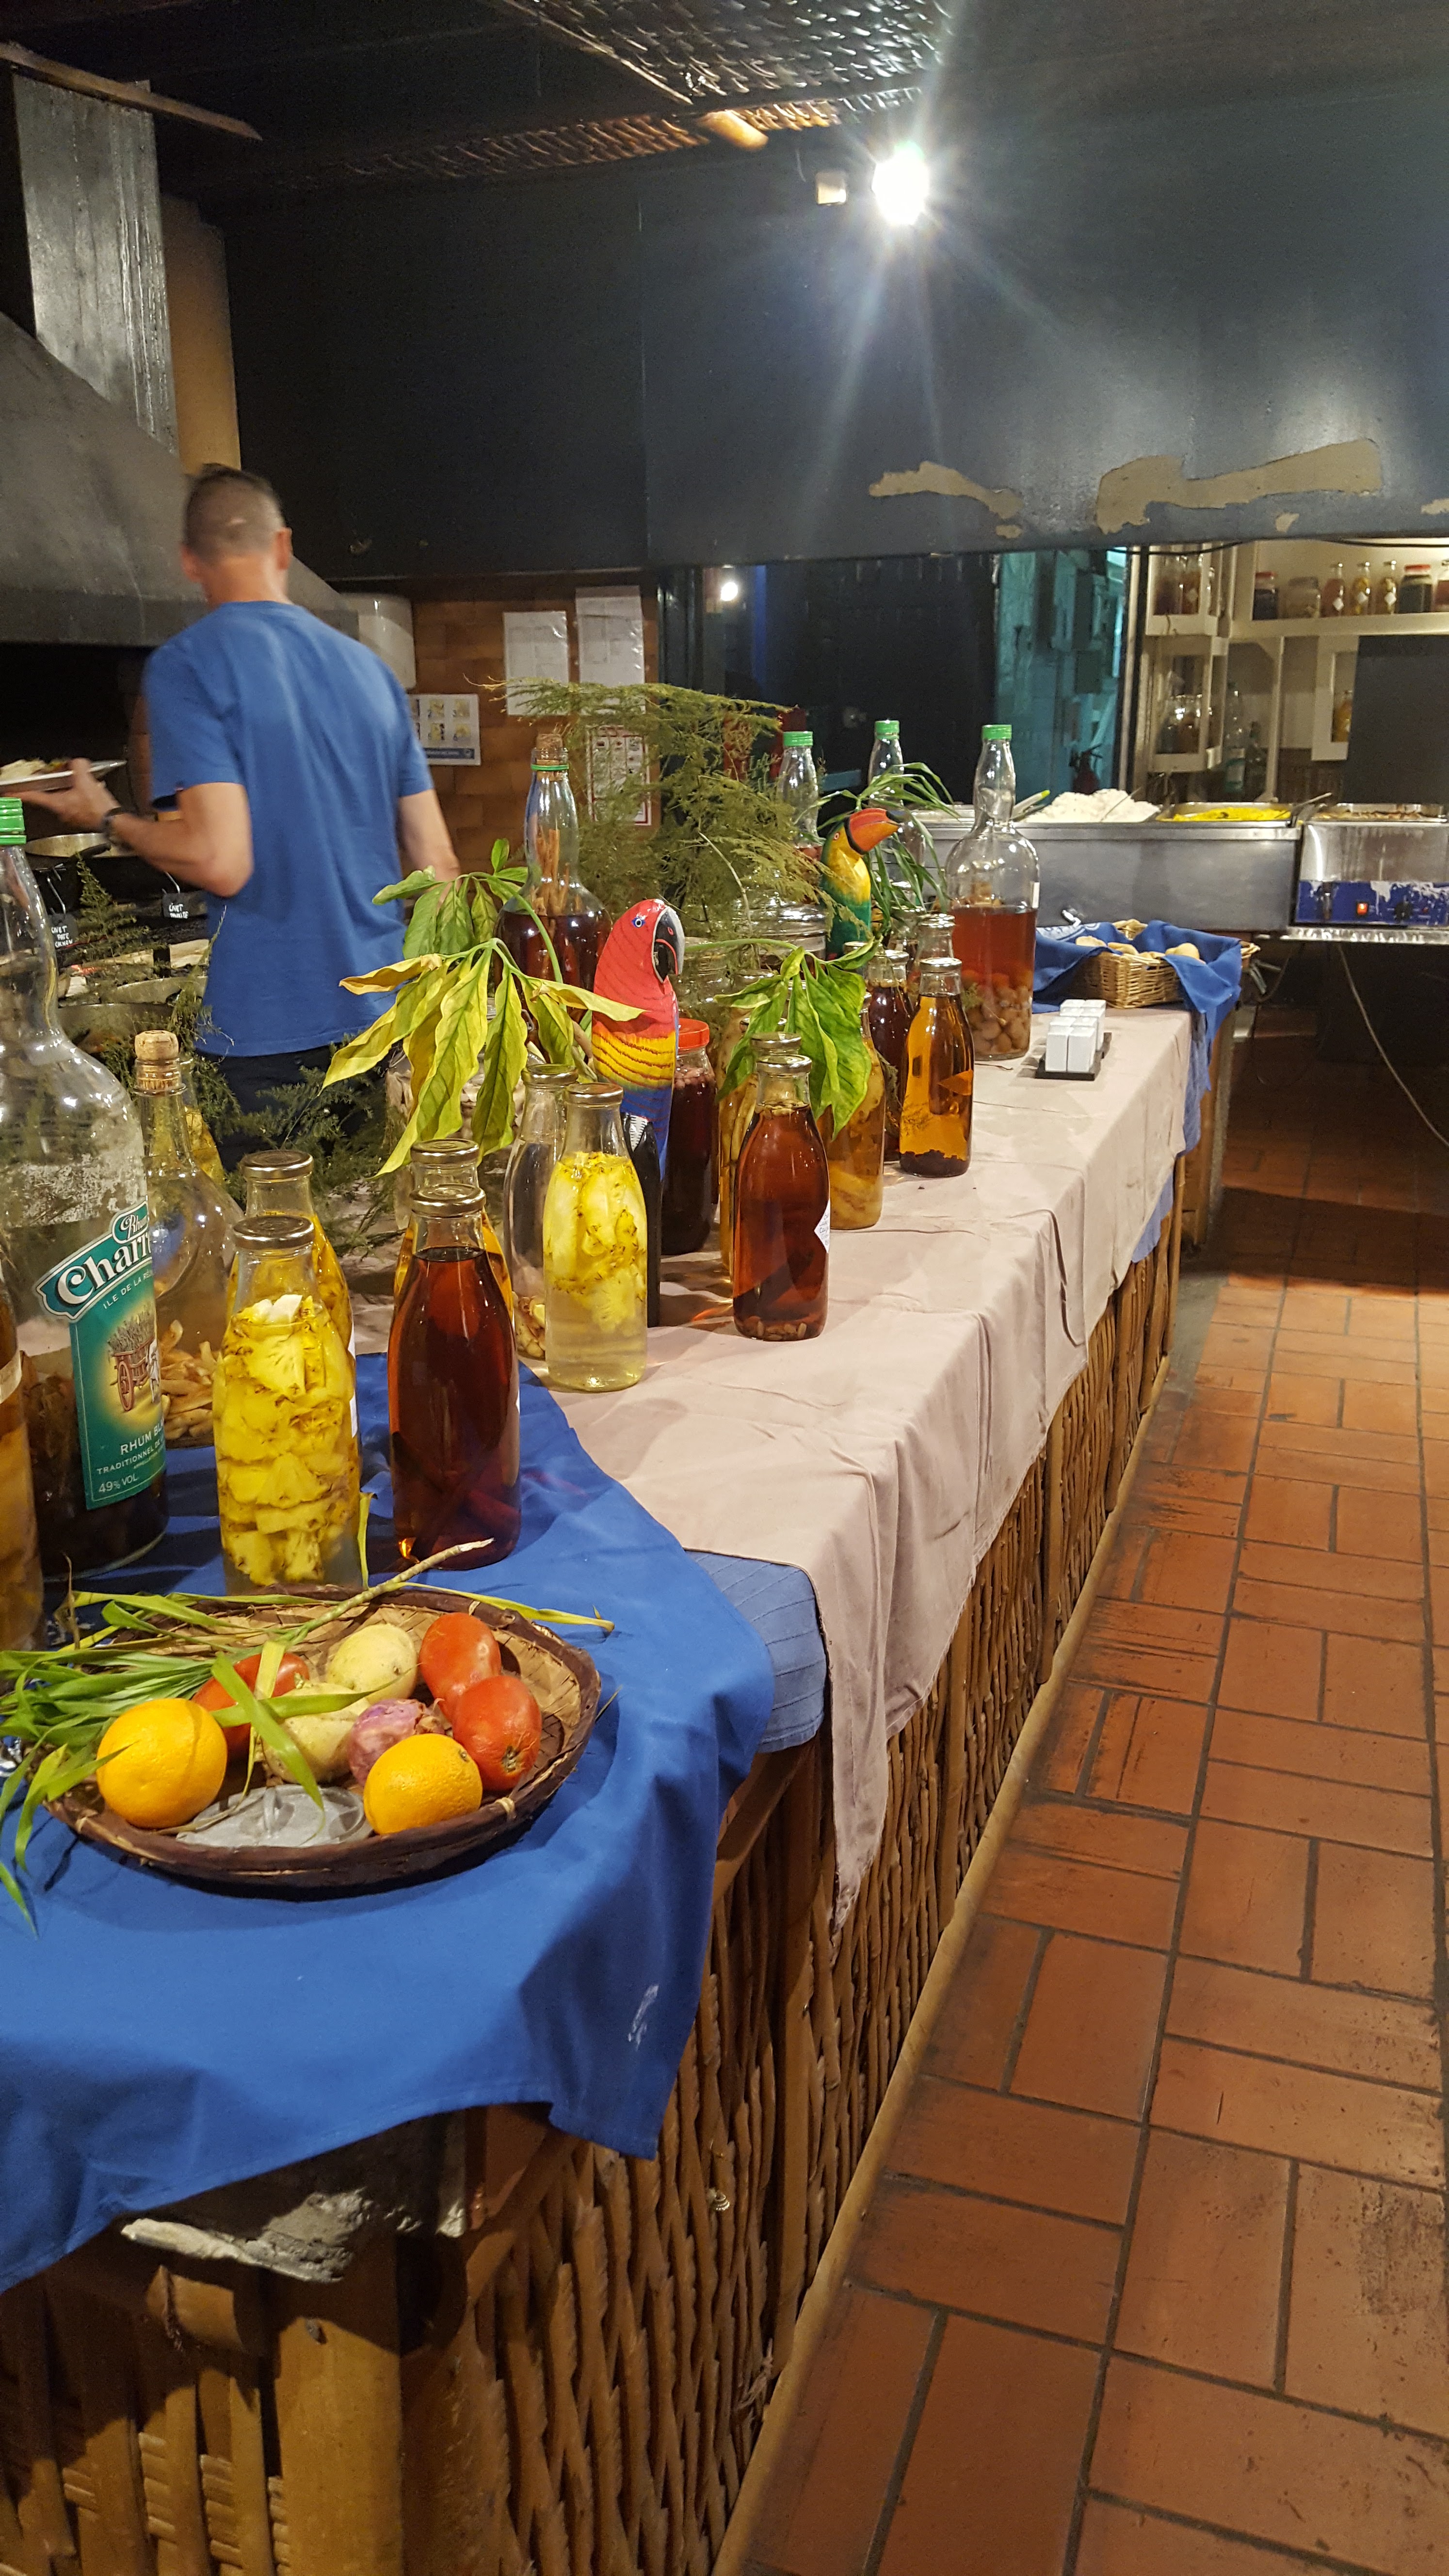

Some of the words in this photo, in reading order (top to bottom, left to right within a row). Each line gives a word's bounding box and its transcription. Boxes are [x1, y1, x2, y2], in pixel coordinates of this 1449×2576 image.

[57, 1232, 151, 1304] Charr
[103, 1294, 119, 1309] ILE
[121, 1284, 132, 1296] DE
[133, 1276, 142, 1287] LA
[121, 1431, 152, 1455] RHUM
[97, 1446, 154, 1475] TRADITIONNEL
[98, 1481, 121, 1493] 49%
